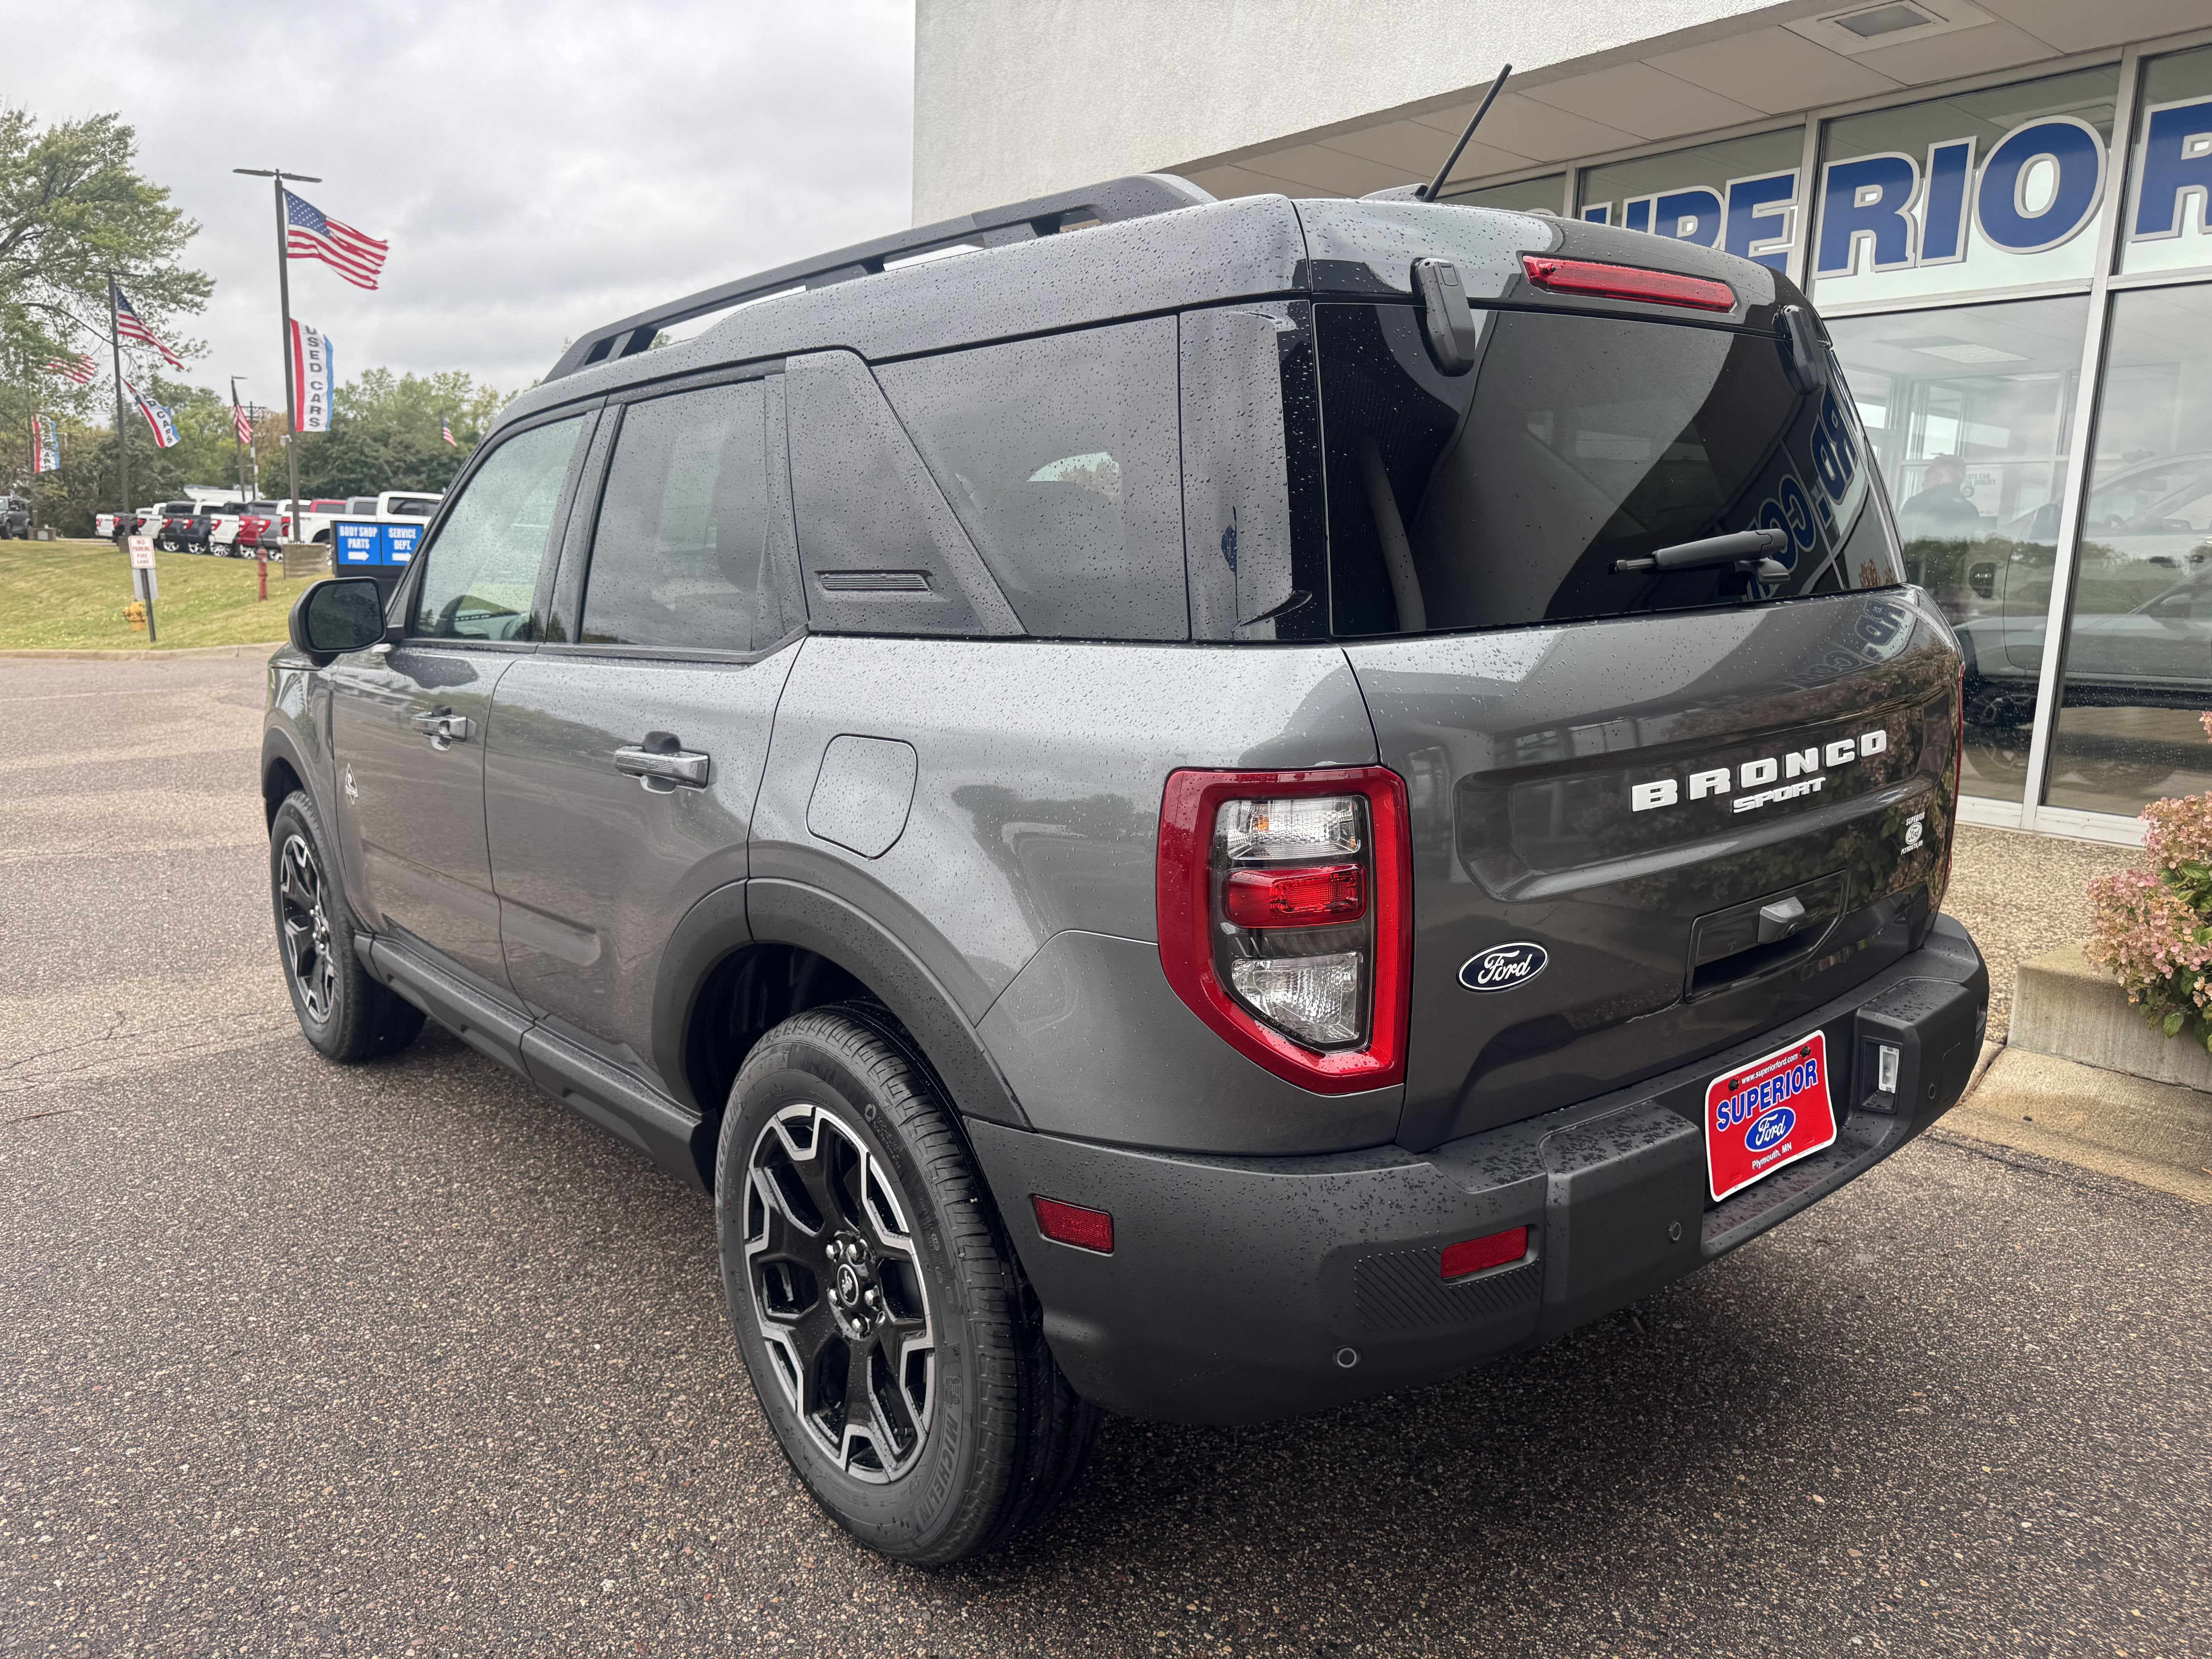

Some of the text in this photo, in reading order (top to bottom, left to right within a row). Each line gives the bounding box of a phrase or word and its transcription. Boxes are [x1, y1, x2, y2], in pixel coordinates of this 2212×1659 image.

[305, 325, 323, 427] USED CARS
[156, 411, 172, 443] CARS
[340, 526, 378, 537] BODY SHOP
[348, 538, 370, 549] PARTS
[388, 528, 416, 539] SERVICE
[394, 539, 412, 550] DEPT.
[1630, 730, 1887, 812] BRONCO
[1731, 777, 1826, 813] SPORT
[1906, 812, 1925, 826] SUPERIOR
[1478, 950, 1533, 984] Ford
[1741, 1053, 1798, 1085] www.superiorford.com
[1716, 1058, 1818, 1132] SUPERIOR
[876, 1117, 898, 1151] MICHELIN
[1755, 1113, 1786, 1146] Ford
[1752, 1149, 1781, 1170] Plymouth,
[1782, 1141, 1792, 1154] MN
[919, 1410, 958, 1524] MICHELIN
